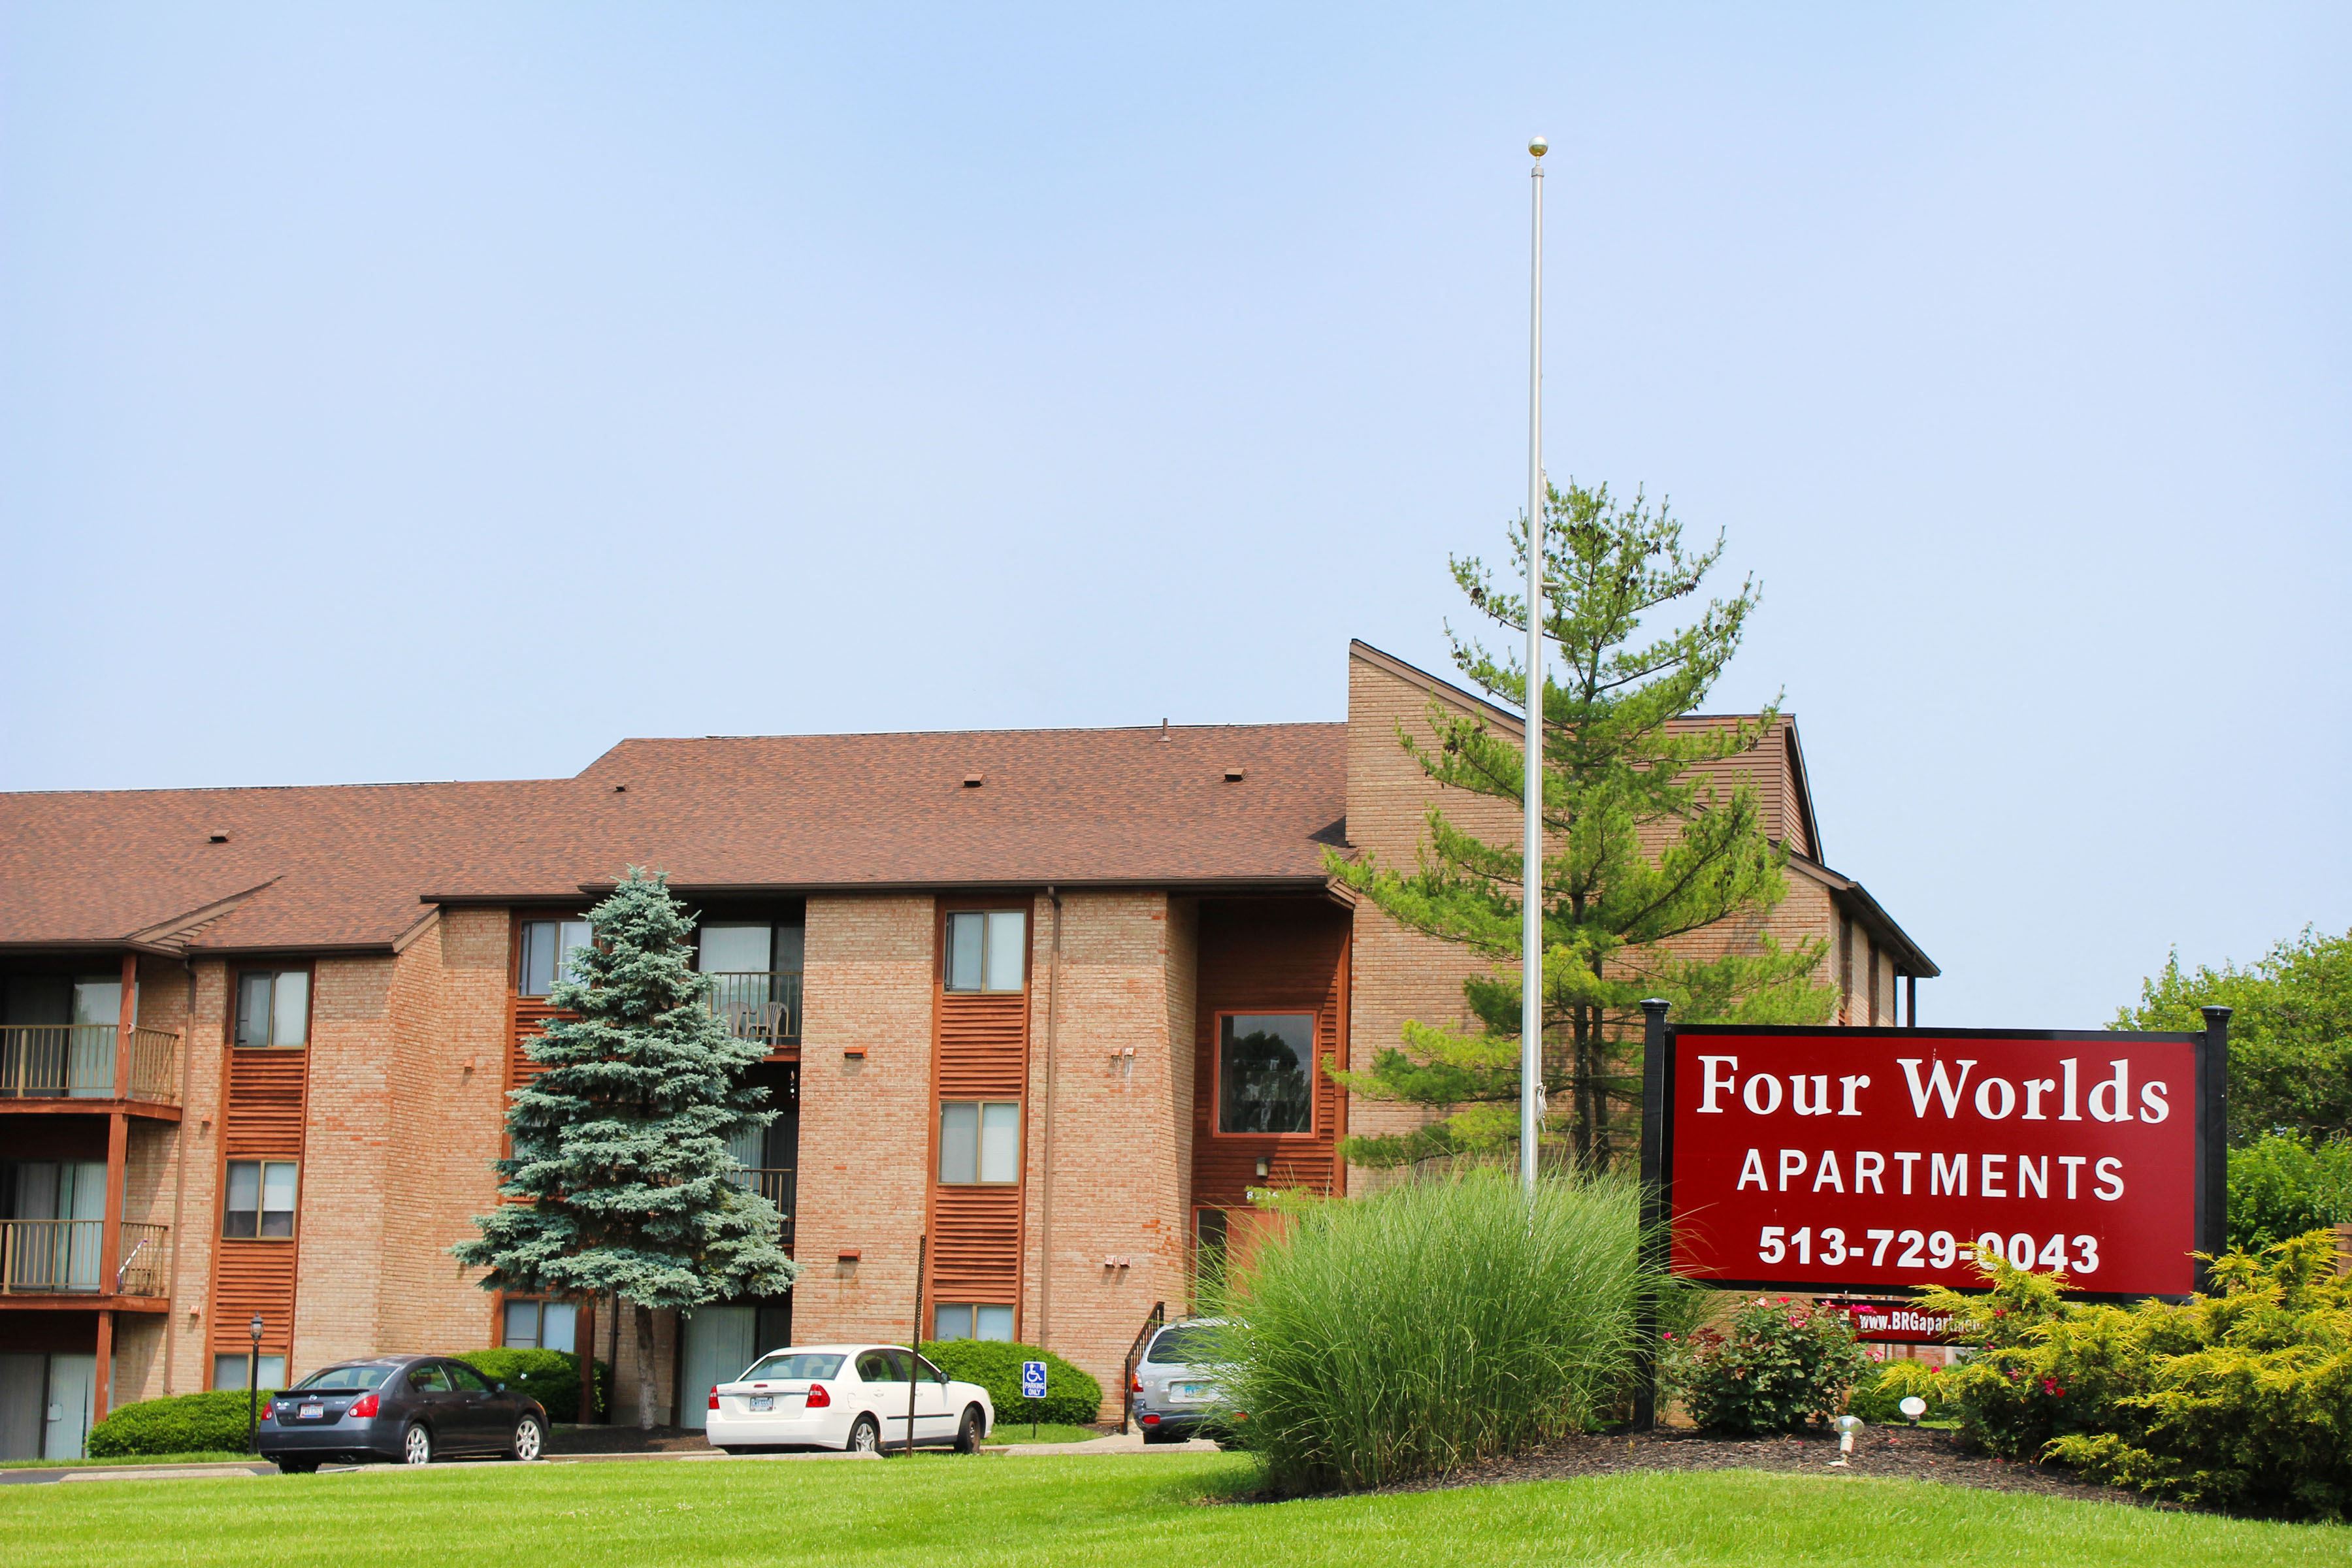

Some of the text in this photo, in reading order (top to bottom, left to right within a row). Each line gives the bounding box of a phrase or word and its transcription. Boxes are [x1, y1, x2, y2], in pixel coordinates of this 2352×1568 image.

[1697, 1056, 2169, 1123] Four Worlds
[1737, 1148, 2125, 1201] APARTMENTS
[1759, 1227, 2099, 1274] 513-729-0043
